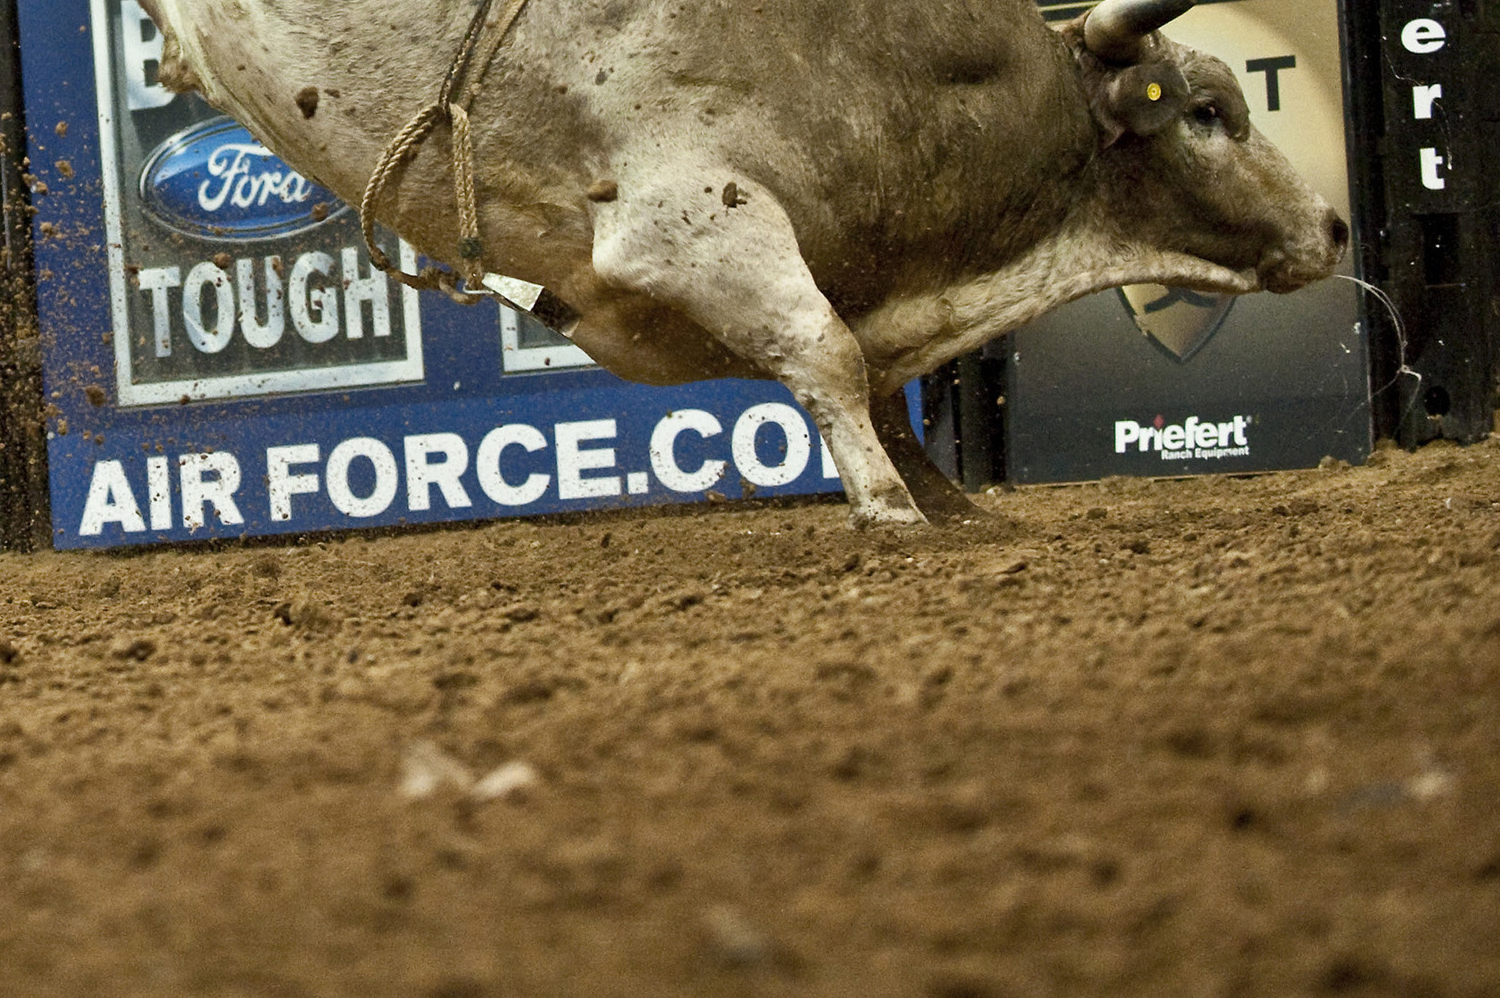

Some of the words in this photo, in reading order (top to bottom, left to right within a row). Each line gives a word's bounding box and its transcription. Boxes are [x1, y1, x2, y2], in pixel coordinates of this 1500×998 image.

[138, 245, 392, 358] TOUGH
[1115, 414, 1248, 454] Priefert
[1161, 449, 1193, 461] Ranch
[1195, 445, 1251, 461] Equipment
[79, 451, 244, 536] AIR
